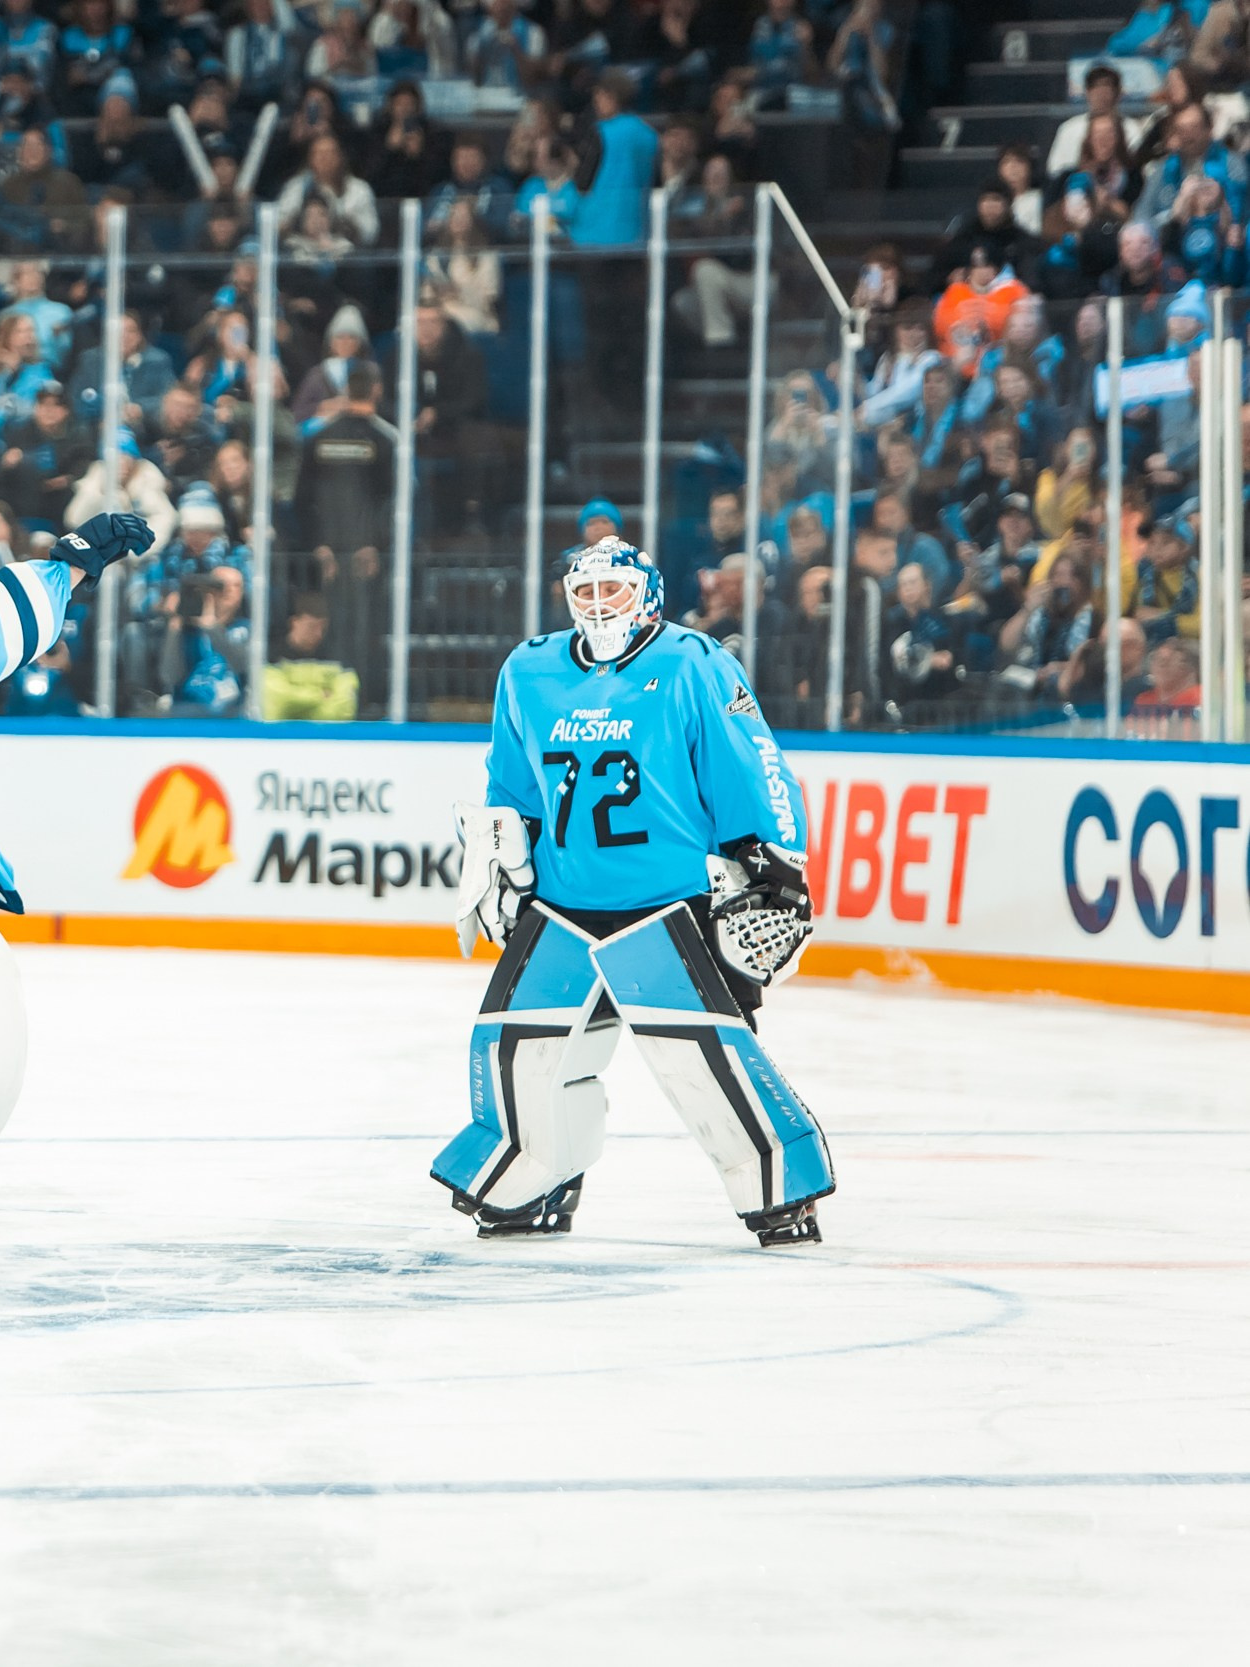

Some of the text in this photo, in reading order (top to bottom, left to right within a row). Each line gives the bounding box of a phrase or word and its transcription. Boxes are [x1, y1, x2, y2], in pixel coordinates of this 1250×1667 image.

[571, 707, 612, 719] FONBET
[256, 770, 393, 818] Яндекс
[543, 750, 649, 848] 72
[254, 831, 463, 898] Марк
[797, 779, 989, 926] NBET
[1064, 782, 1250, 938] СОГ
